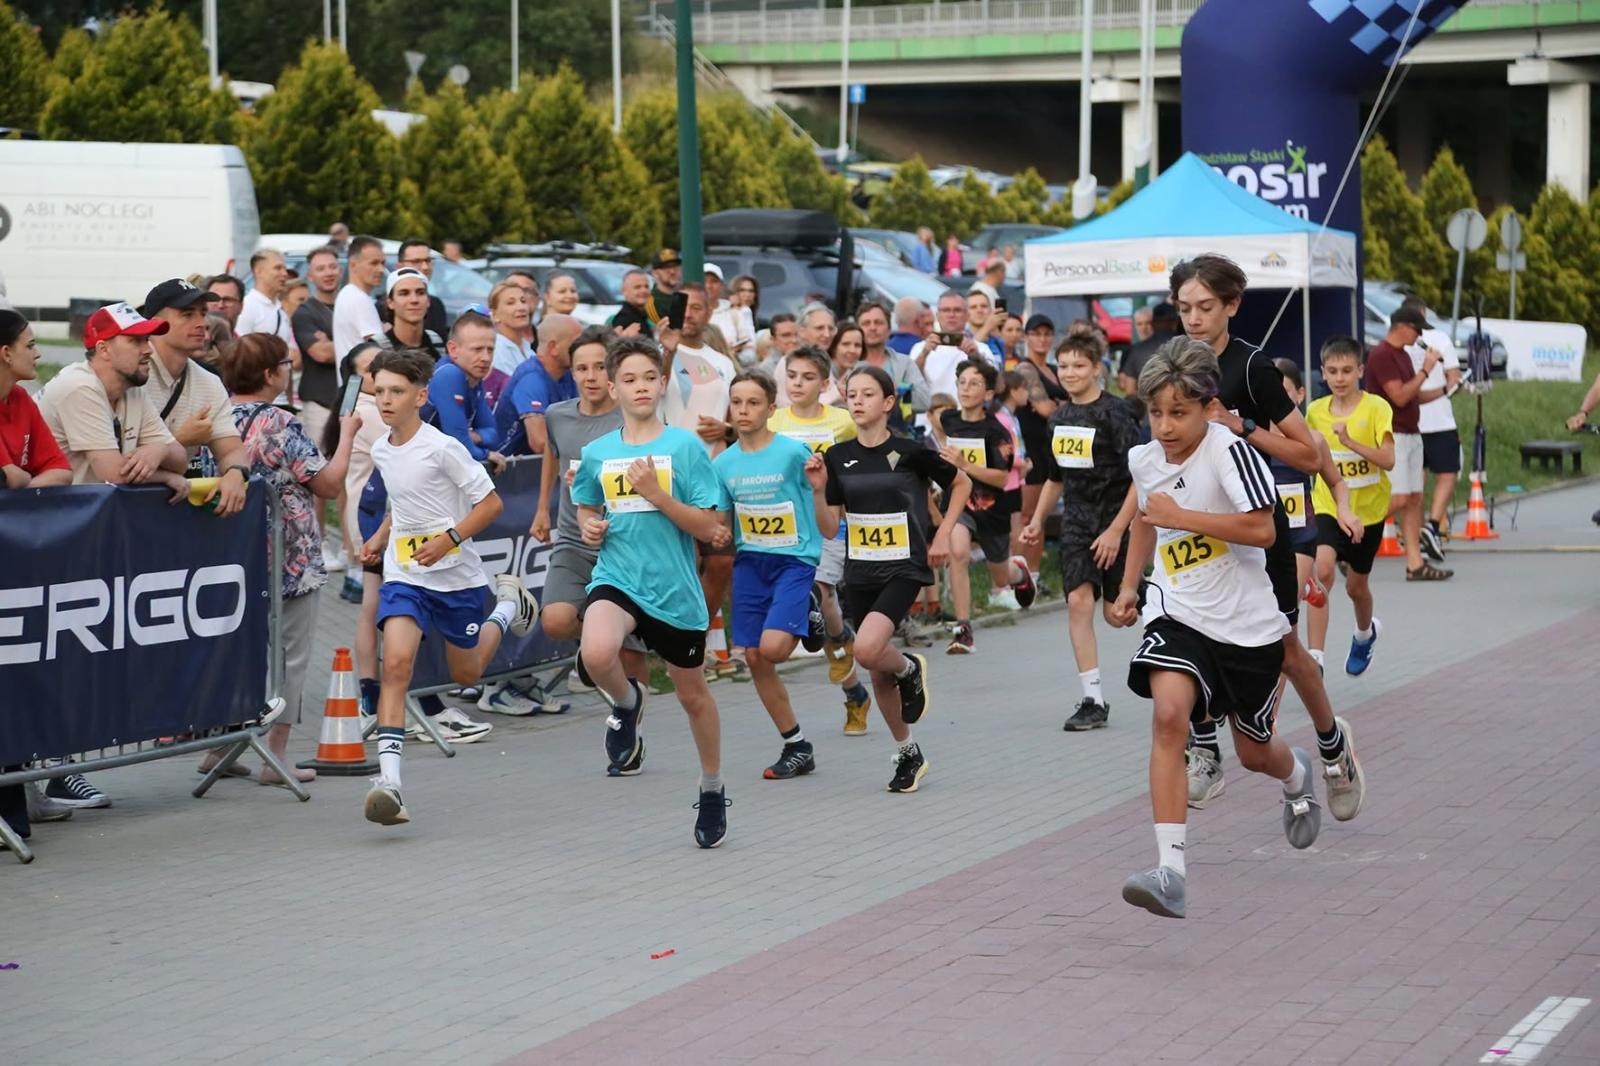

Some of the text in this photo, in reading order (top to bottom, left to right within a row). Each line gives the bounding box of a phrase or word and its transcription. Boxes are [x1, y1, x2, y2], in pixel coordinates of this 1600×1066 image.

[1249, 148, 1285, 163] Śląski
[1212, 162, 1328, 201] osir
[24, 202, 154, 218] ABI NOCLEGI
[1058, 438, 1084, 456] 124
[1336, 460, 1370, 477] 138
[747, 516, 786, 535] 122
[858, 526, 897, 547] 141
[1167, 534, 1212, 570] 125
